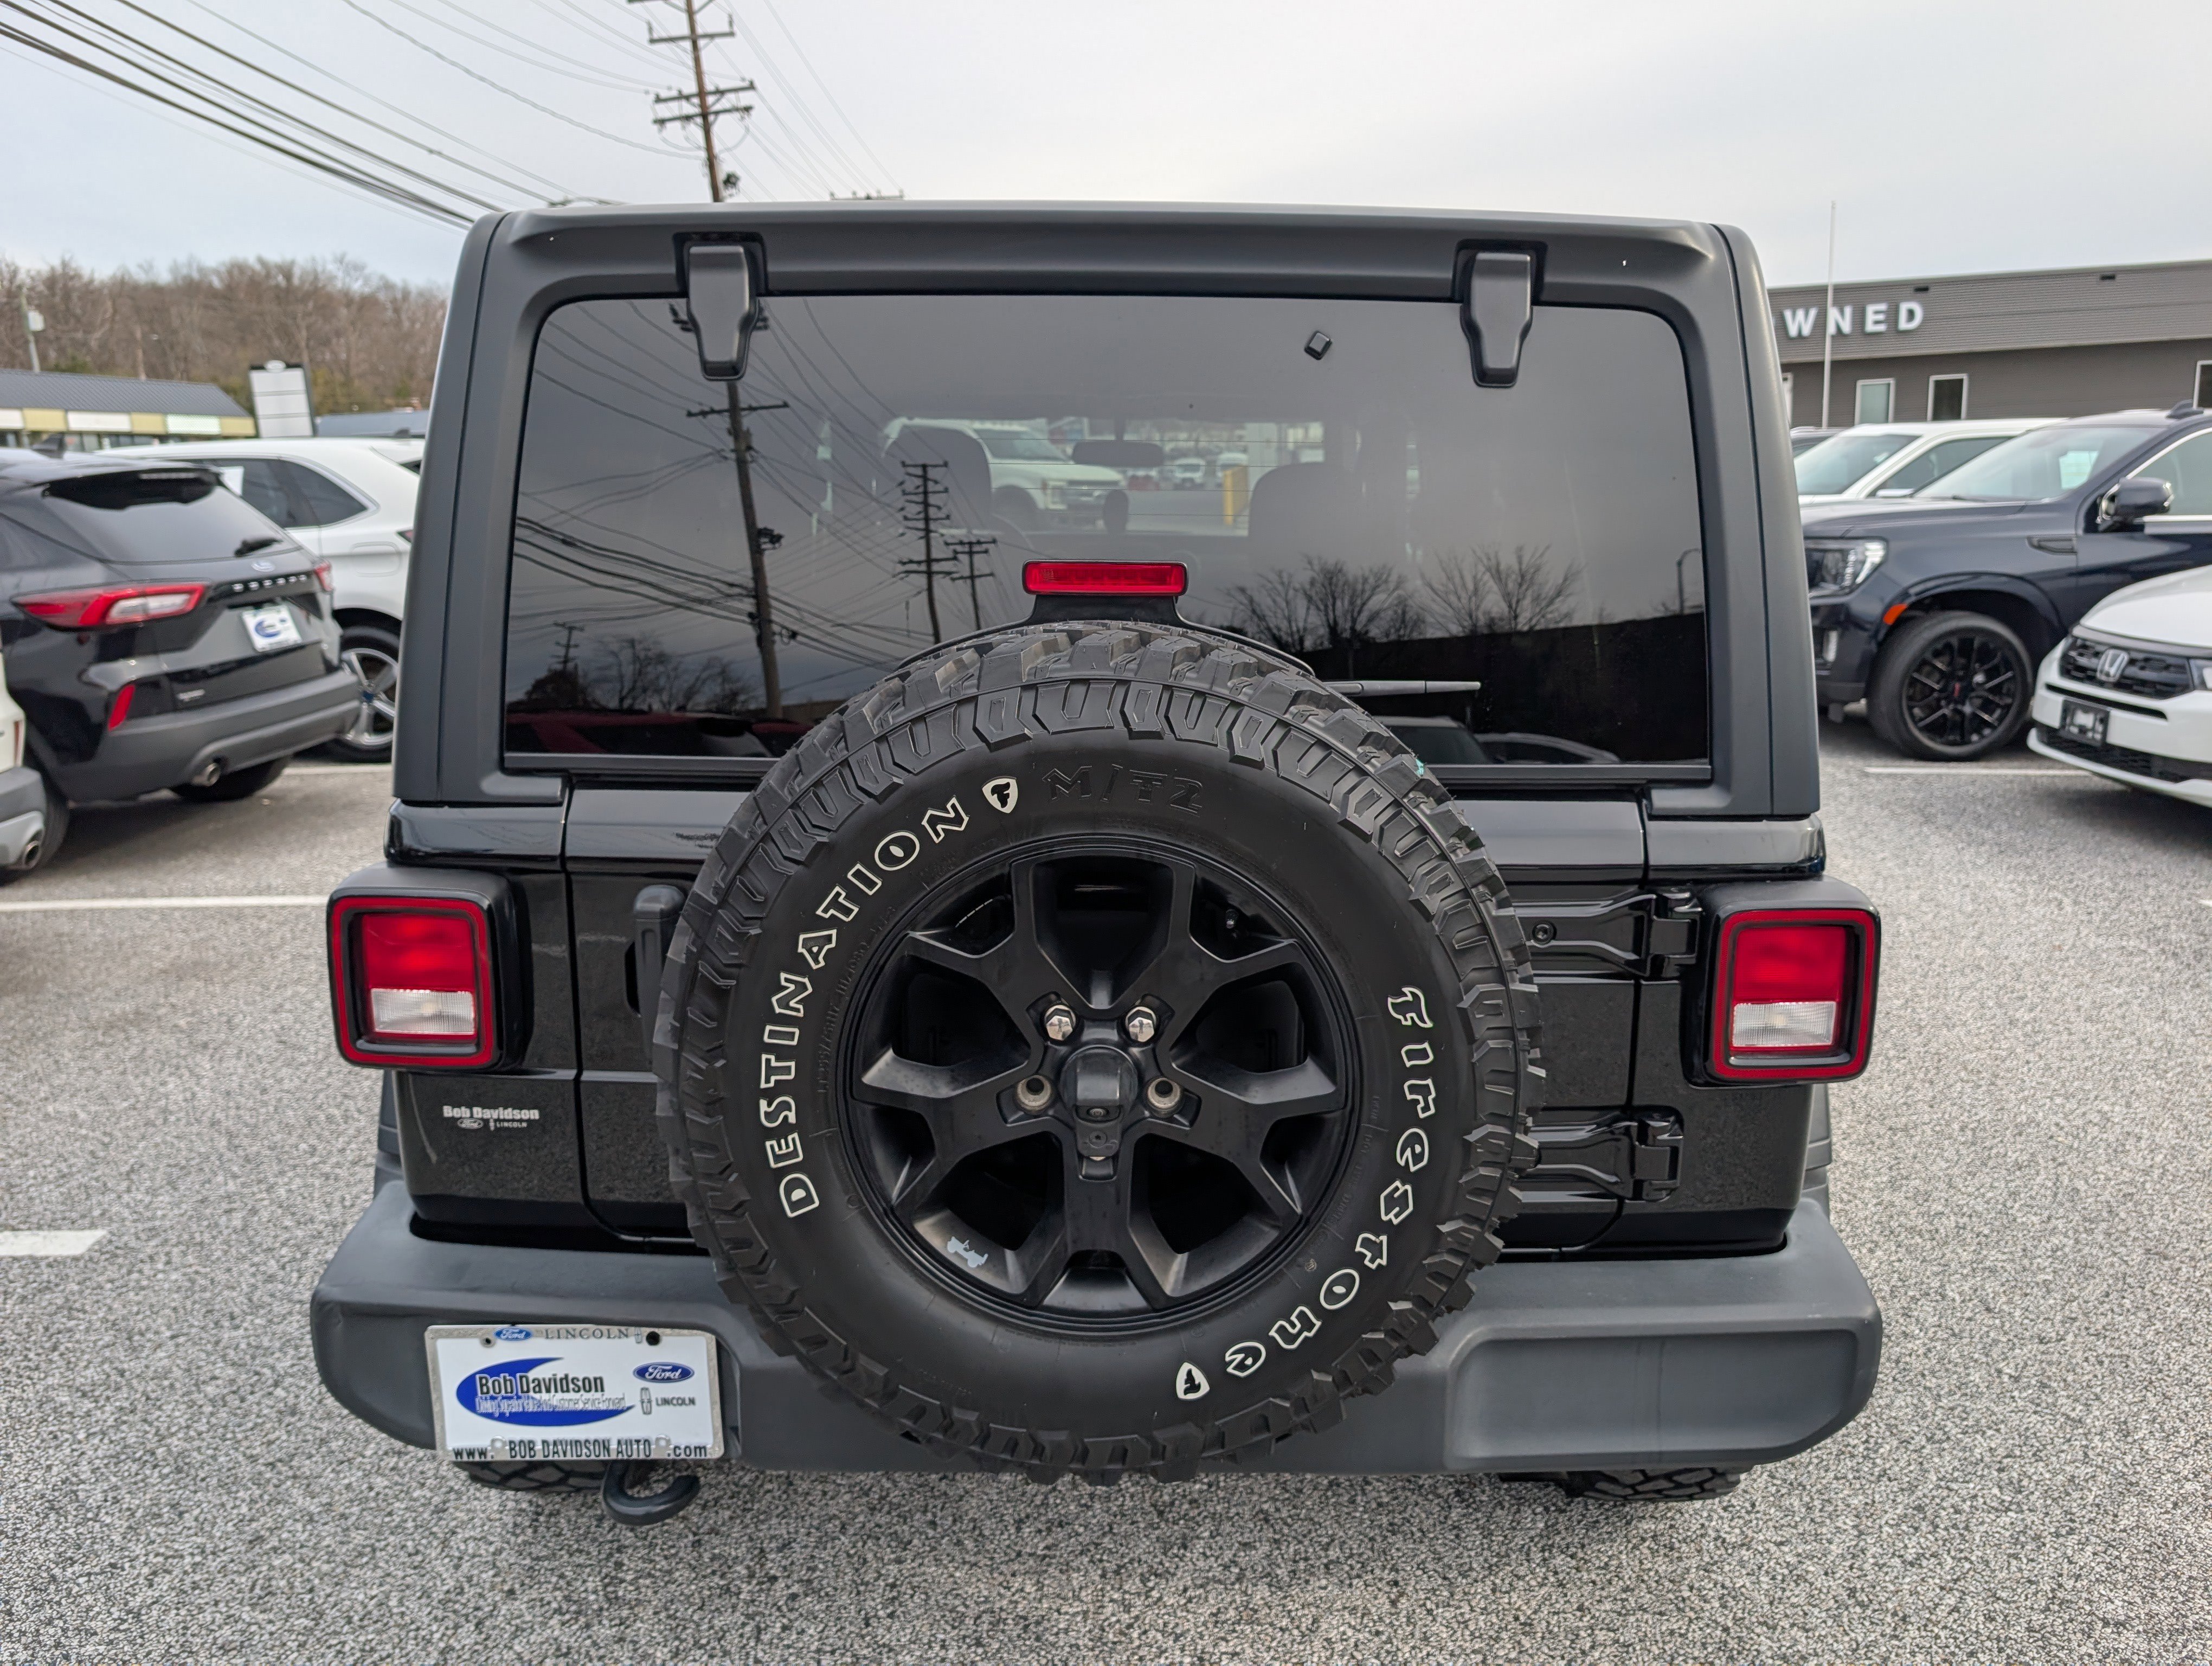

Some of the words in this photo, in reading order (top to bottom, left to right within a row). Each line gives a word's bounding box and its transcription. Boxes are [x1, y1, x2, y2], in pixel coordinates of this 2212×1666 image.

[1773, 301, 1924, 338] WNED
[760, 796, 969, 1218] DESTINATION
[443, 1105, 471, 1118] Bob
[472, 1107, 540, 1120] Davidson
[1225, 986, 1435, 1377] Firestone
[499, 1328, 526, 1340] Ford
[544, 1328, 629, 1340] LINCOLN
[642, 1364, 684, 1381] Ford
[478, 1374, 514, 1395] Bob
[519, 1373, 605, 1394] Davidson
[654, 1396, 696, 1406] LINCOLN
[453, 1446, 494, 1459] www.
[509, 1439, 536, 1459] BOB
[541, 1438, 611, 1458] DAVIDSON
[616, 1438, 652, 1458] AUTO
